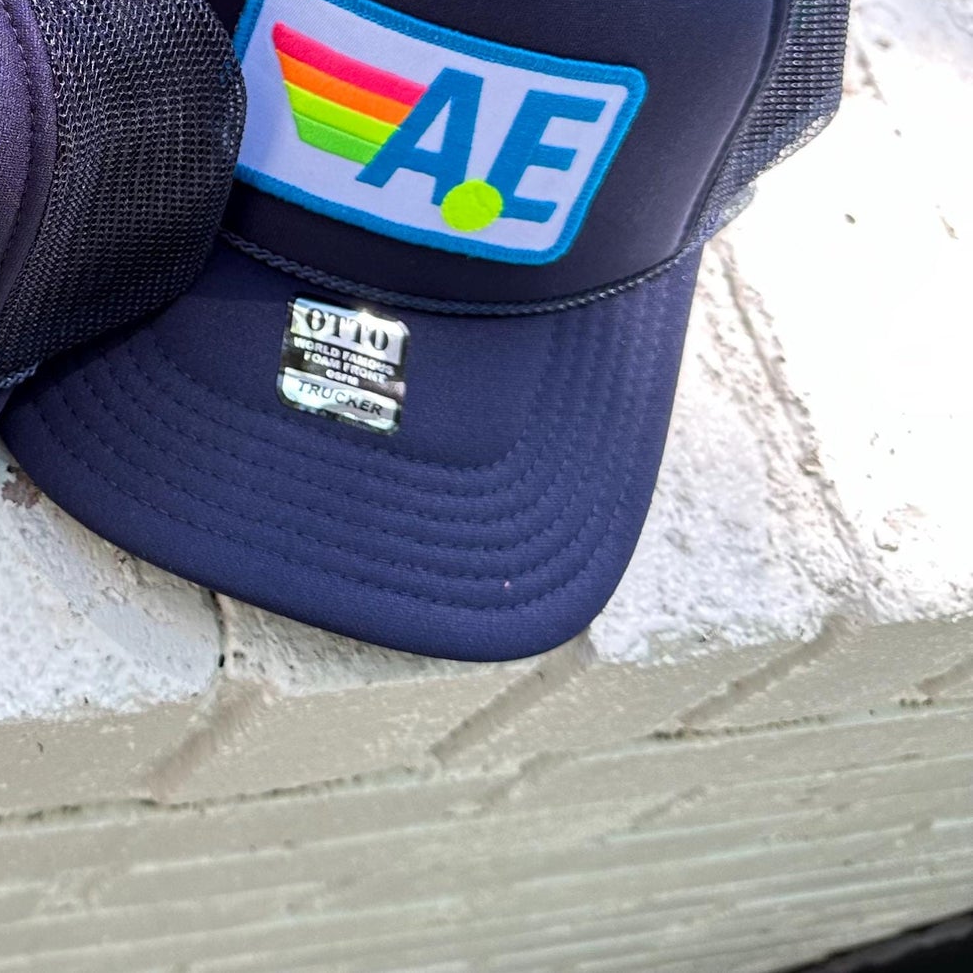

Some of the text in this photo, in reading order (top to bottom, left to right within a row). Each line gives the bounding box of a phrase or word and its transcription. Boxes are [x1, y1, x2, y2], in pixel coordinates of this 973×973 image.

[355, 67, 606, 223] AE
[306, 308, 389, 350] OTTO
[293, 337, 396, 376] WORLD FAMOUS
[303, 351, 388, 385] FOAM FRONT
[298, 380, 383, 415] TRUCKER
